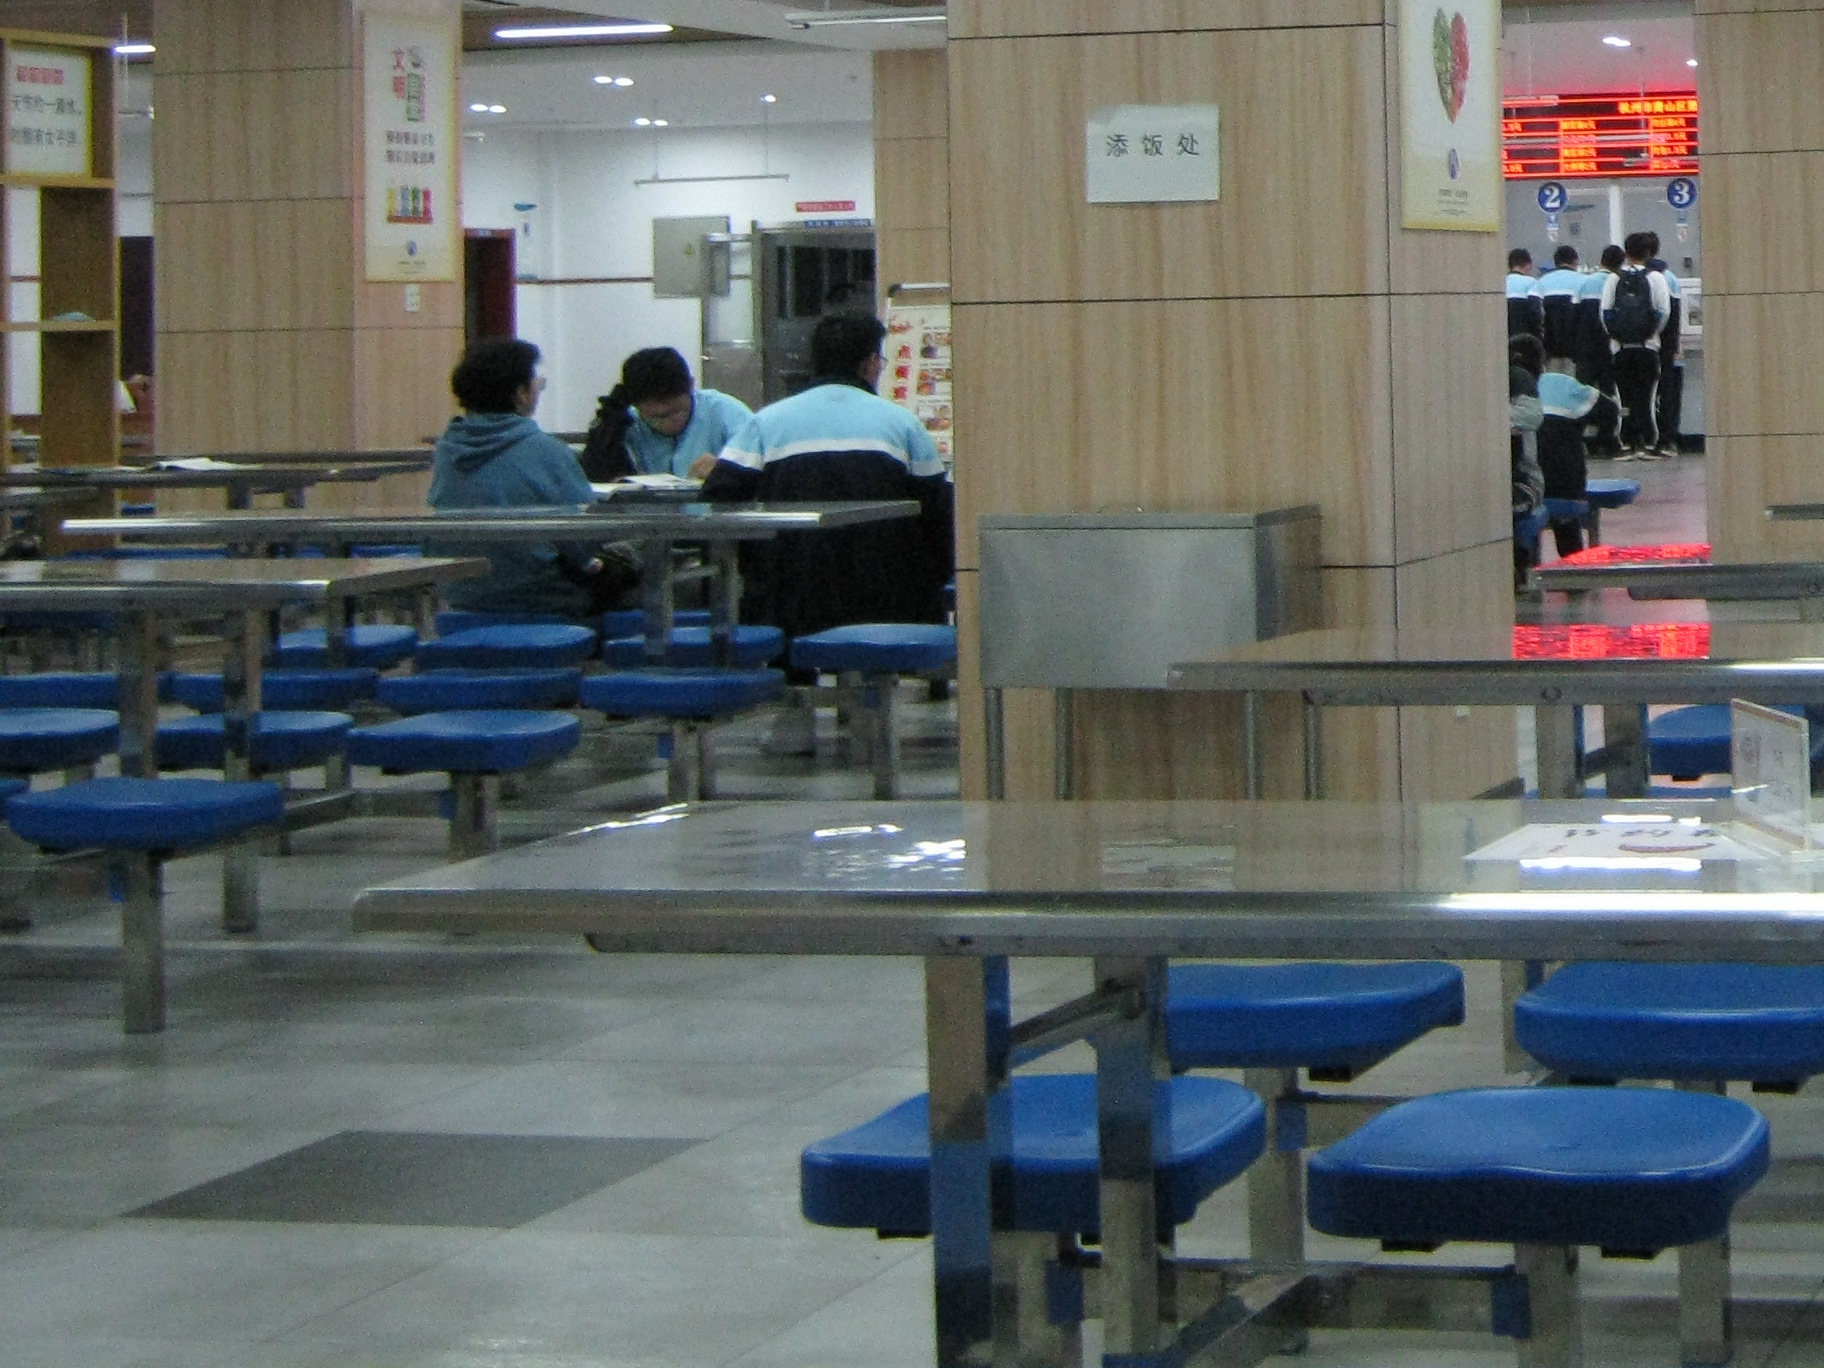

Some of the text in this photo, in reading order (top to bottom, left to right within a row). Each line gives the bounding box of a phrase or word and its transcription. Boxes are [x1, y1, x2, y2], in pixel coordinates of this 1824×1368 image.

[1105, 134, 1200, 157] 添饭处
[1544, 186, 1561, 208] 2
[1673, 182, 1690, 205] 3
